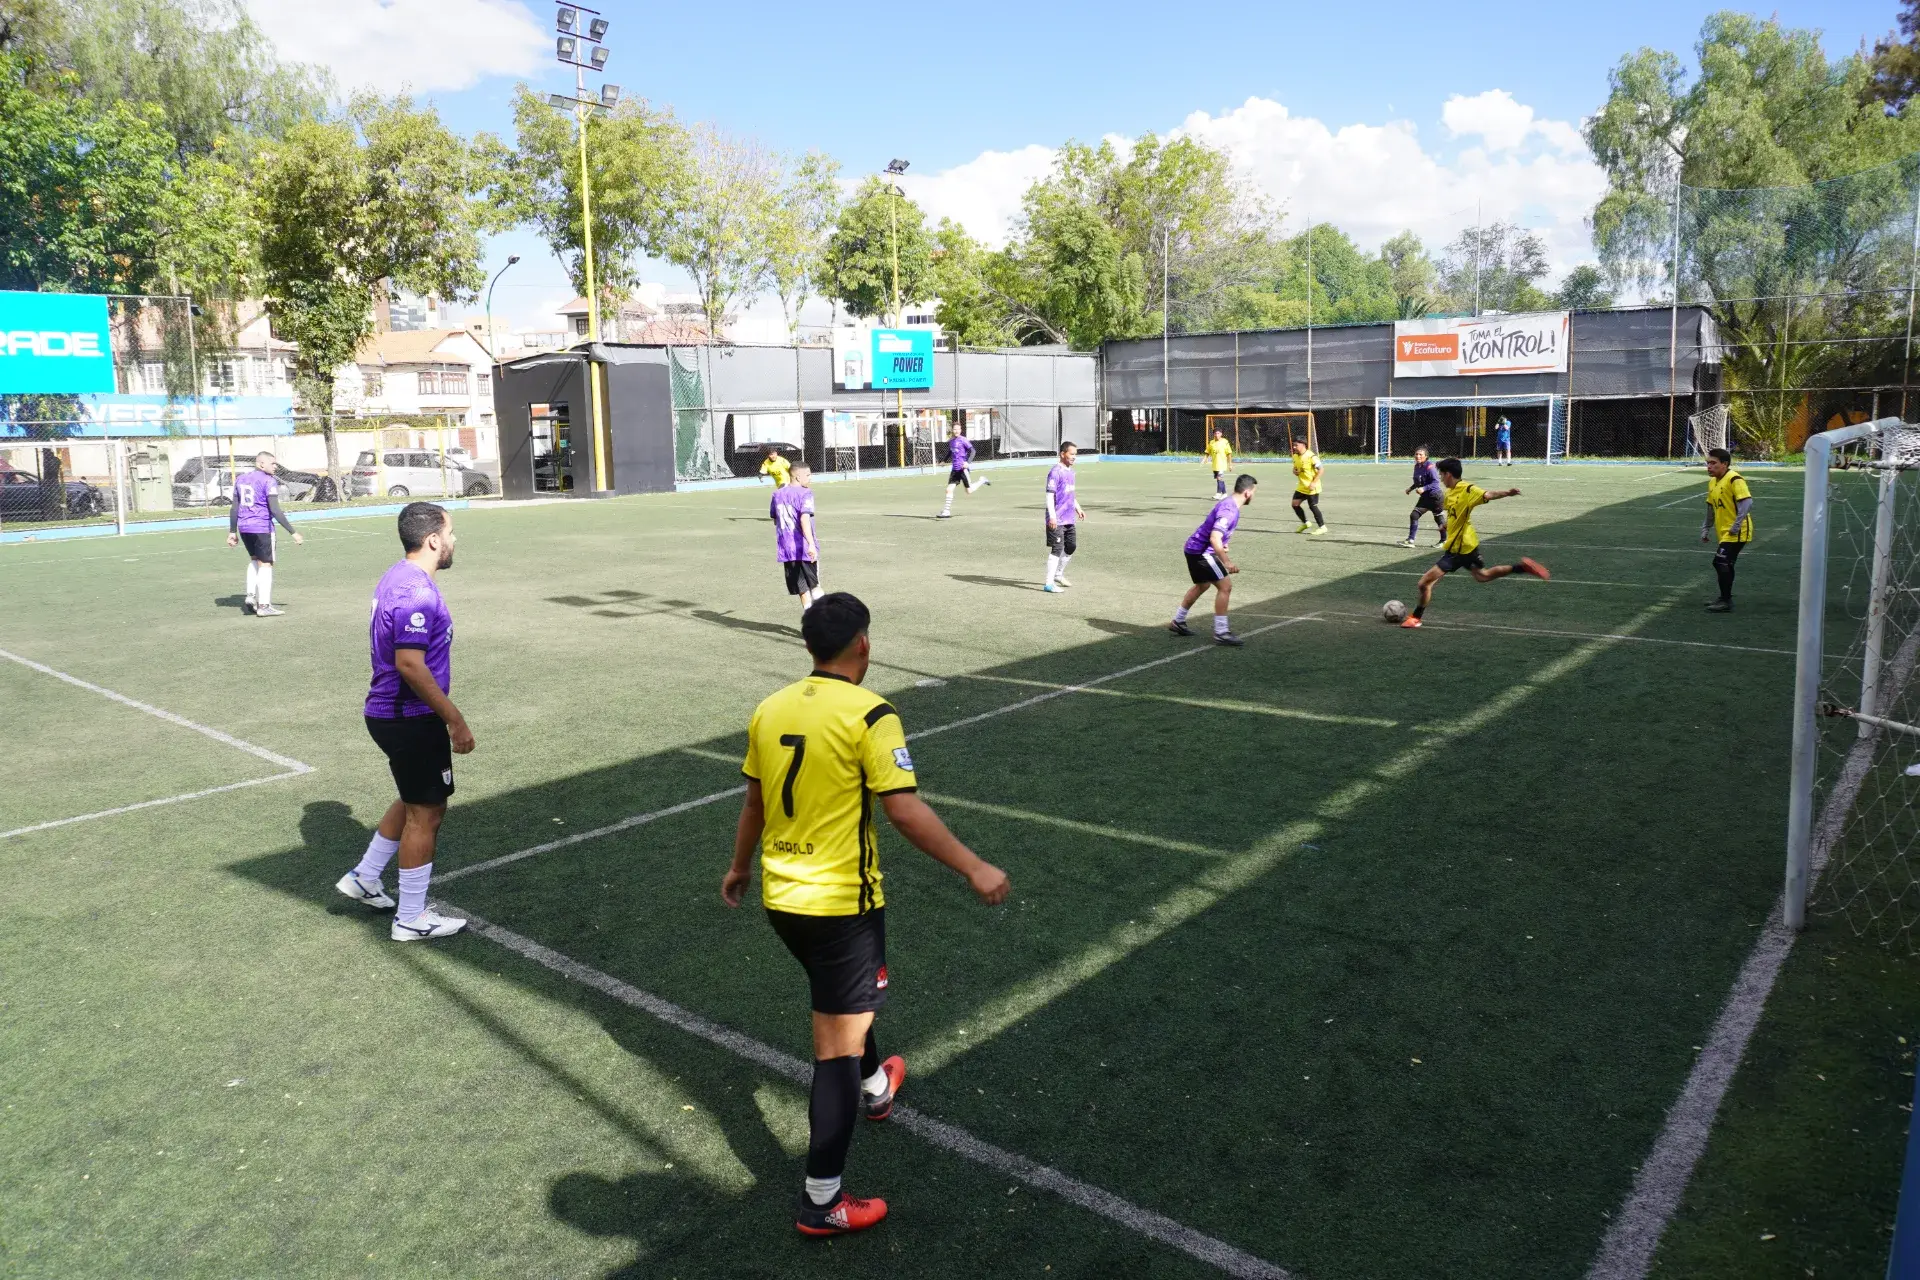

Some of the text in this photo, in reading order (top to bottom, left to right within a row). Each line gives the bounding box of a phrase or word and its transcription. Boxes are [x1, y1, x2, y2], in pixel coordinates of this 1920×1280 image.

[1468, 326, 1505, 342] TOMA EL
[0, 330, 104, 357] ADE
[1414, 346, 1452, 354] Ecofuturo
[892, 356, 924, 373] POWER
[780, 734, 806, 818] 7
[772, 838, 814, 855] HAROLD
[824, 1215, 851, 1229] adidas
